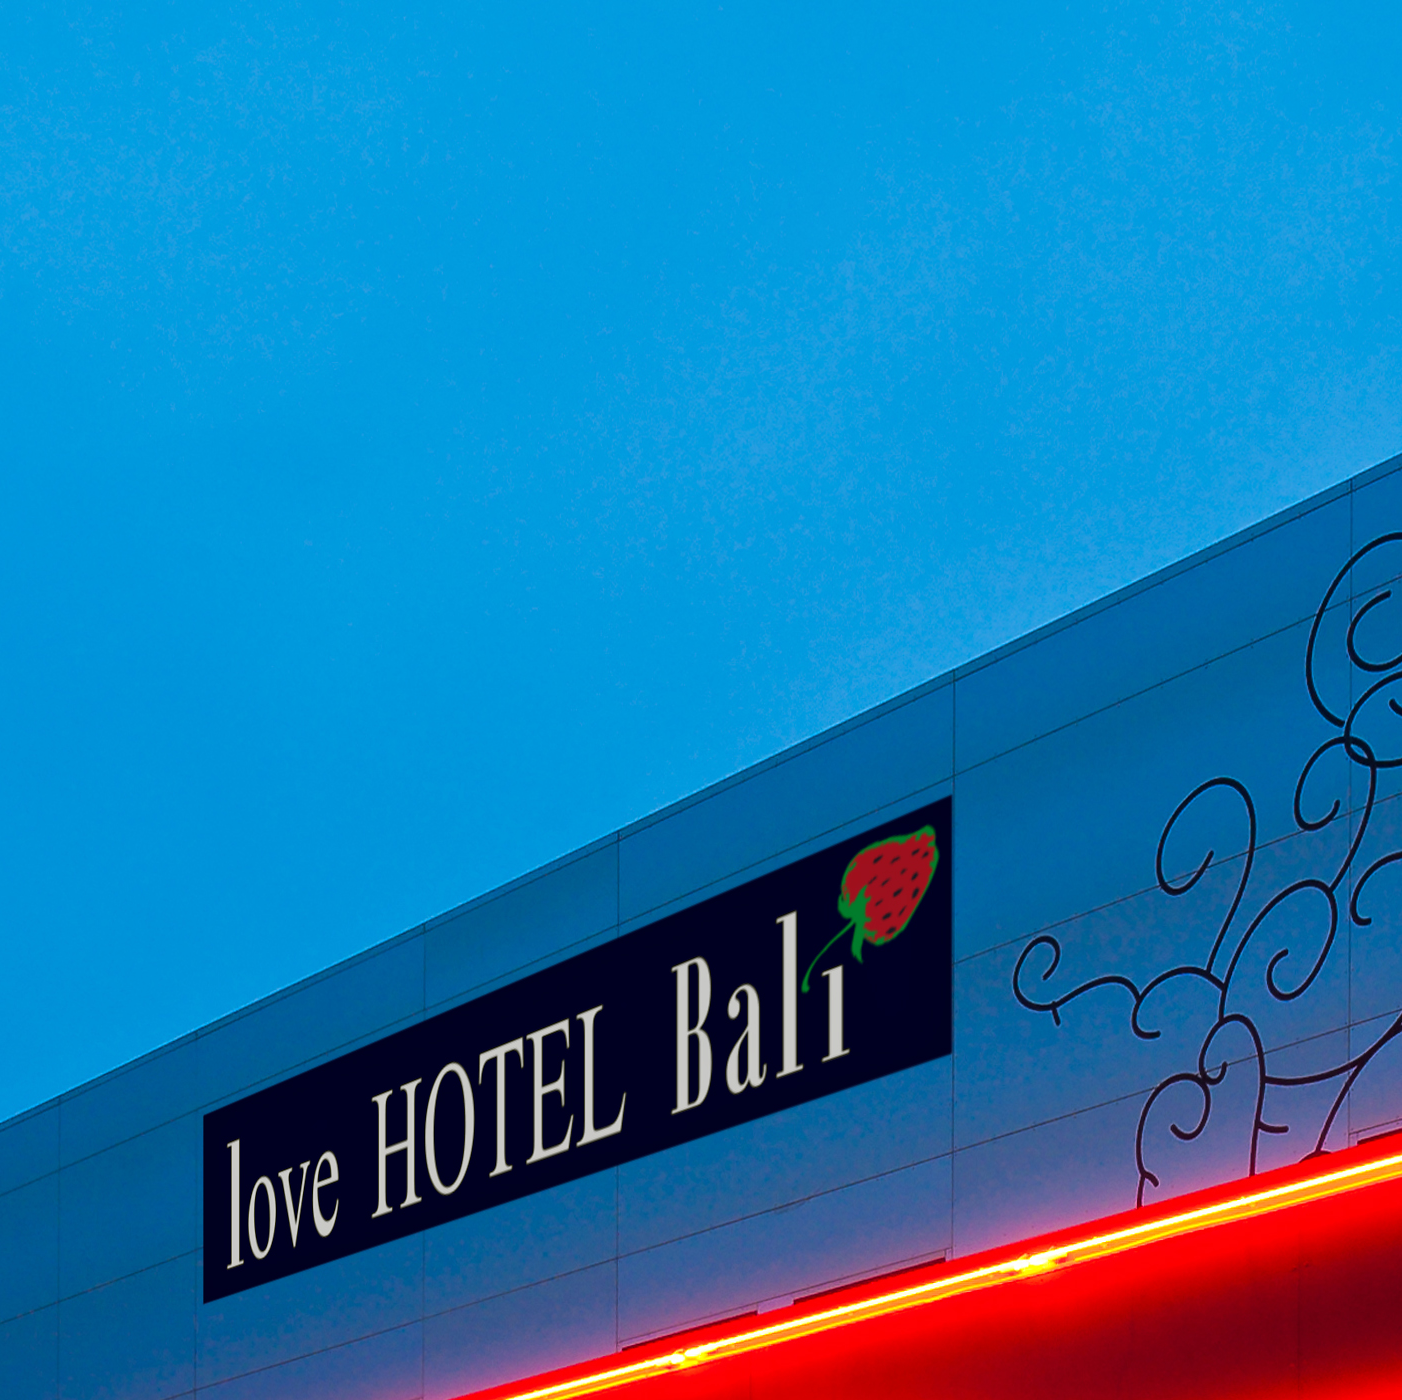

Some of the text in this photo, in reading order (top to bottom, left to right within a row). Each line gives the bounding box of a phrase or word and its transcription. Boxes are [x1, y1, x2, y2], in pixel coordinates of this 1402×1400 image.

[226, 909, 850, 1270] love HOTEL Bali
